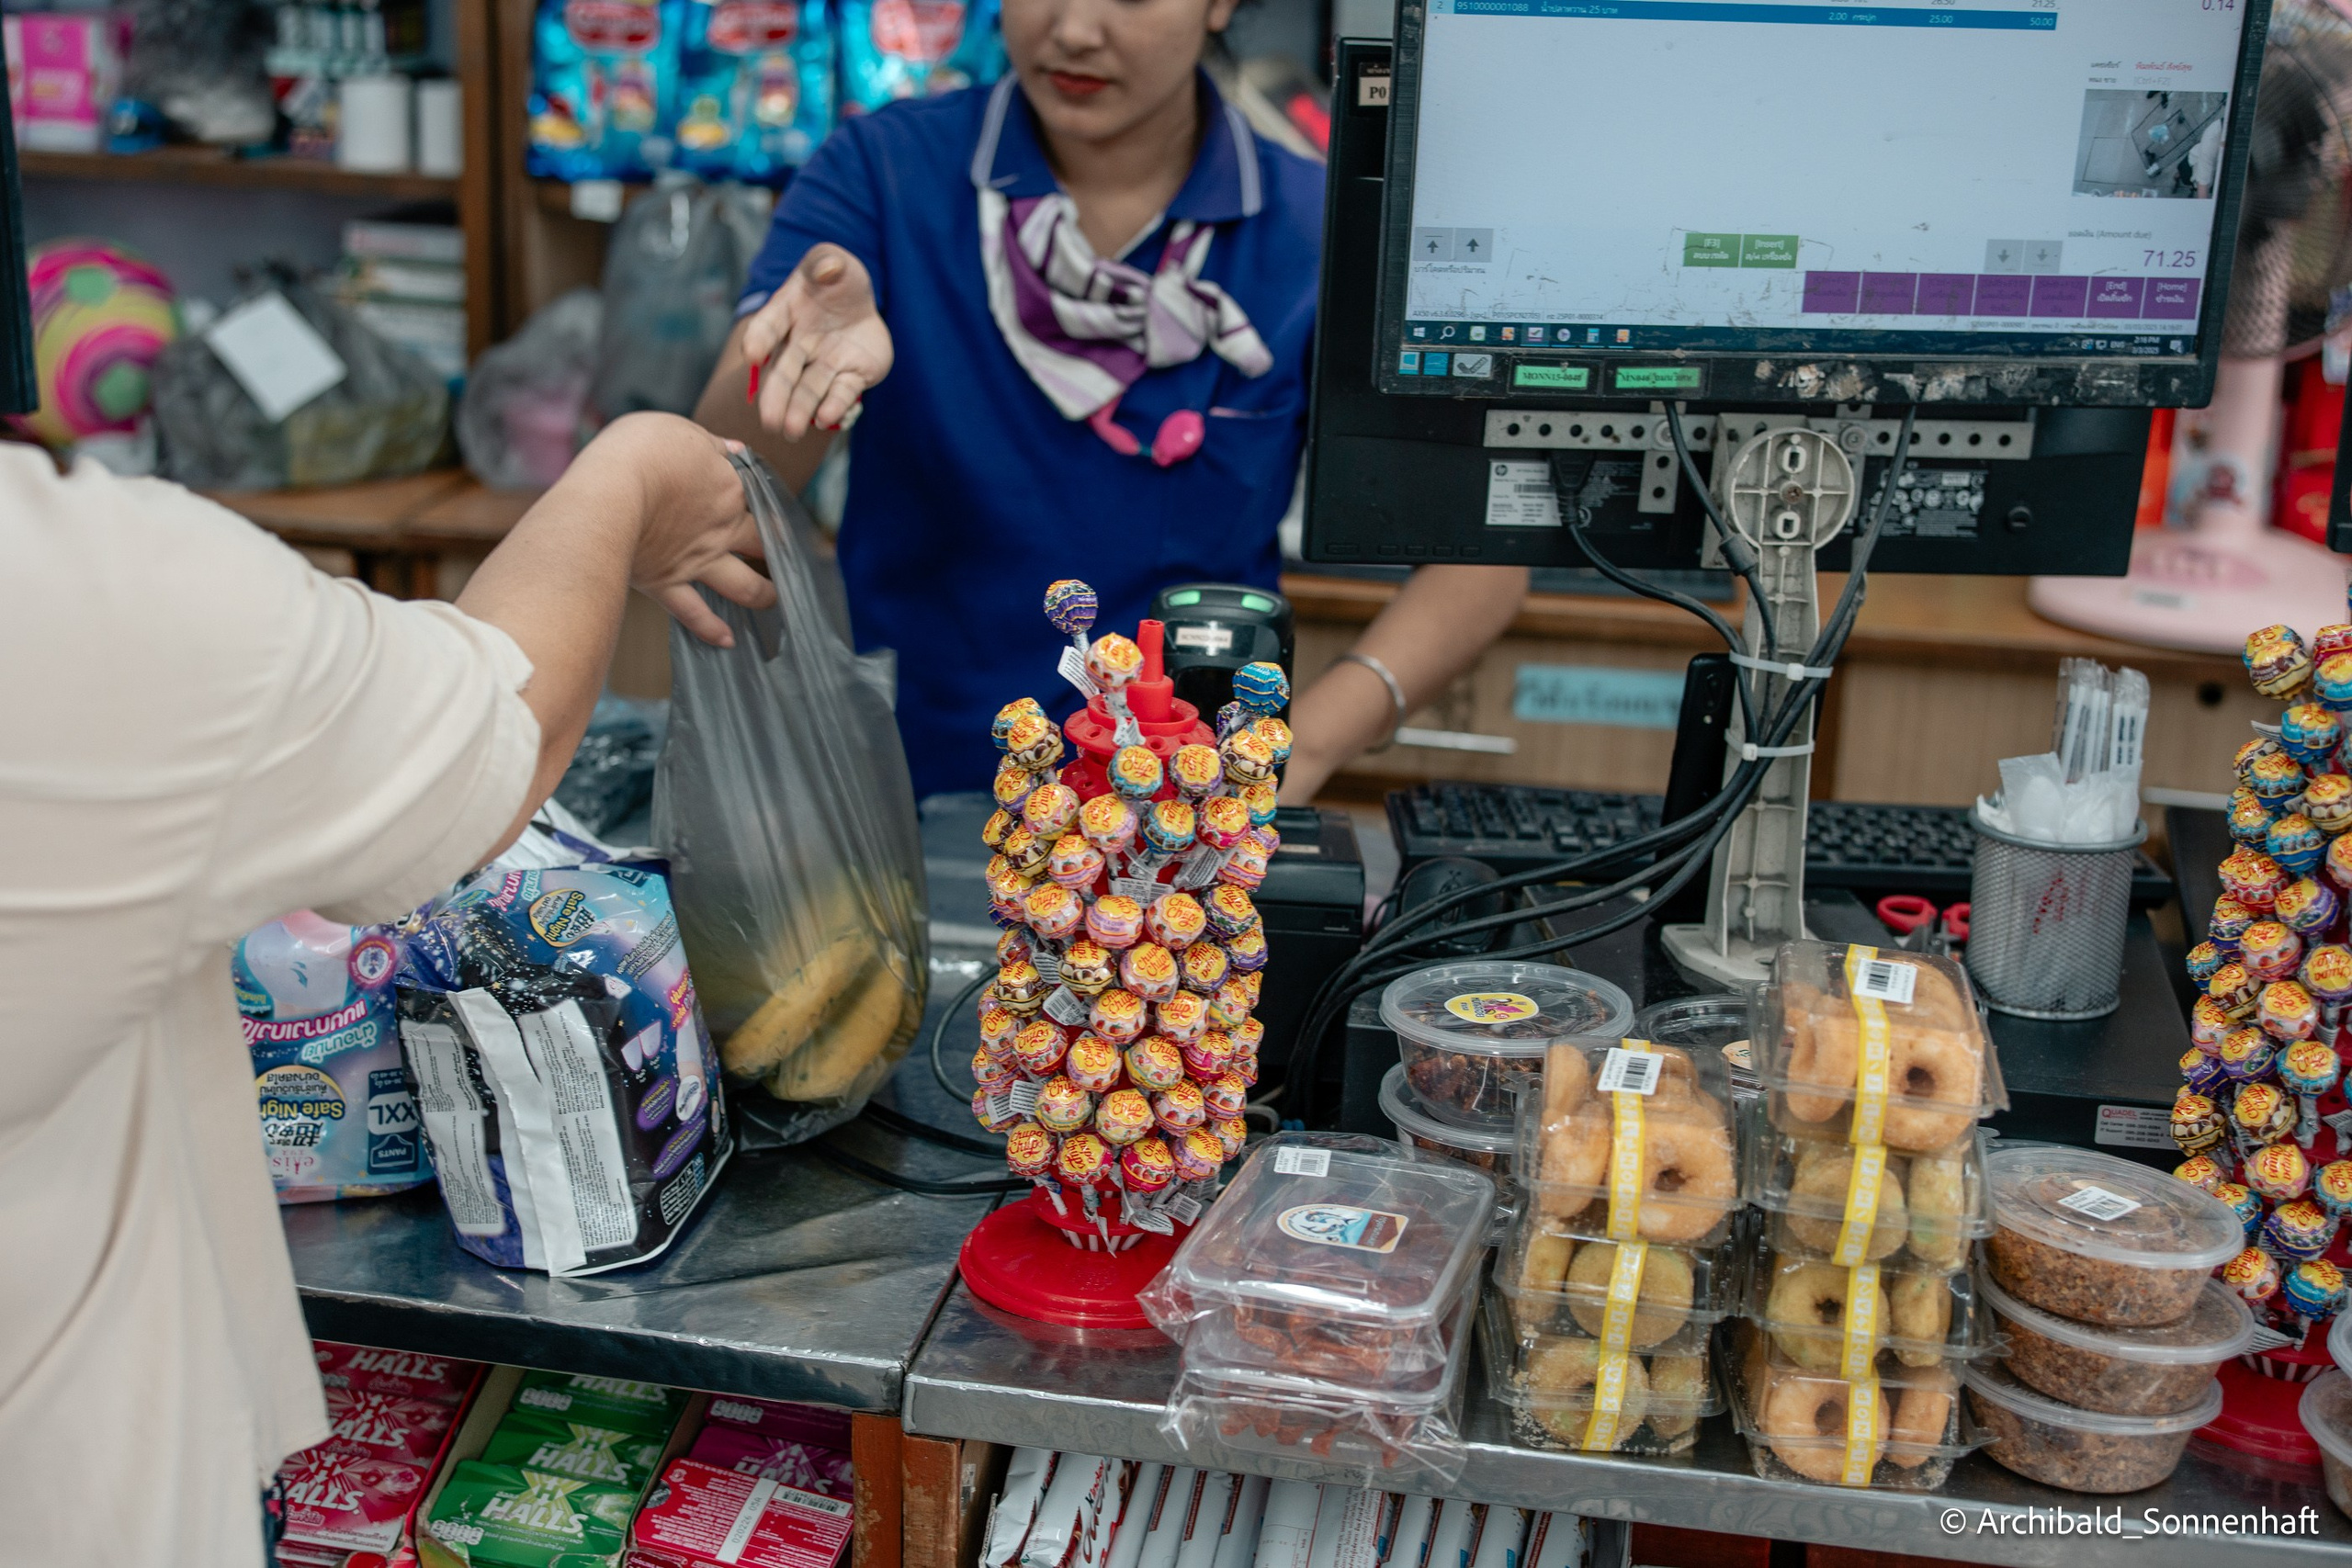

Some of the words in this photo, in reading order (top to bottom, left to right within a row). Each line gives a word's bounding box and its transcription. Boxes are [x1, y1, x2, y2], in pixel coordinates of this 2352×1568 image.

[1589, 6, 1600, 14] 25
[1828, 12, 1848, 21] 2.00
[1928, 15, 1953, 24] 25.00
[2029, 17, 2053, 27] 50.00
[2143, 250, 2197, 268] 71.25
[2105, 282, 2128, 292] [End]
[2156, 282, 2188, 293] [Home]
[561, 890, 585, 916] Safe
[545, 916, 570, 942] Night
[241, 999, 367, 1046] แบบกางเกงใ
[302, 1021, 378, 1063] ผ้าอนามัย
[261, 1100, 300, 1122] Nigh
[302, 1100, 347, 1121] Safe
[2101, 1108, 2137, 1119] QUADEL
[377, 1147, 407, 1159] PANTS
[1009, 1137, 1045, 1158] Chups
[346, 1349, 450, 1383] HALLS
[527, 1446, 633, 1484] HALLS
[480, 1496, 590, 1537] HALLS
